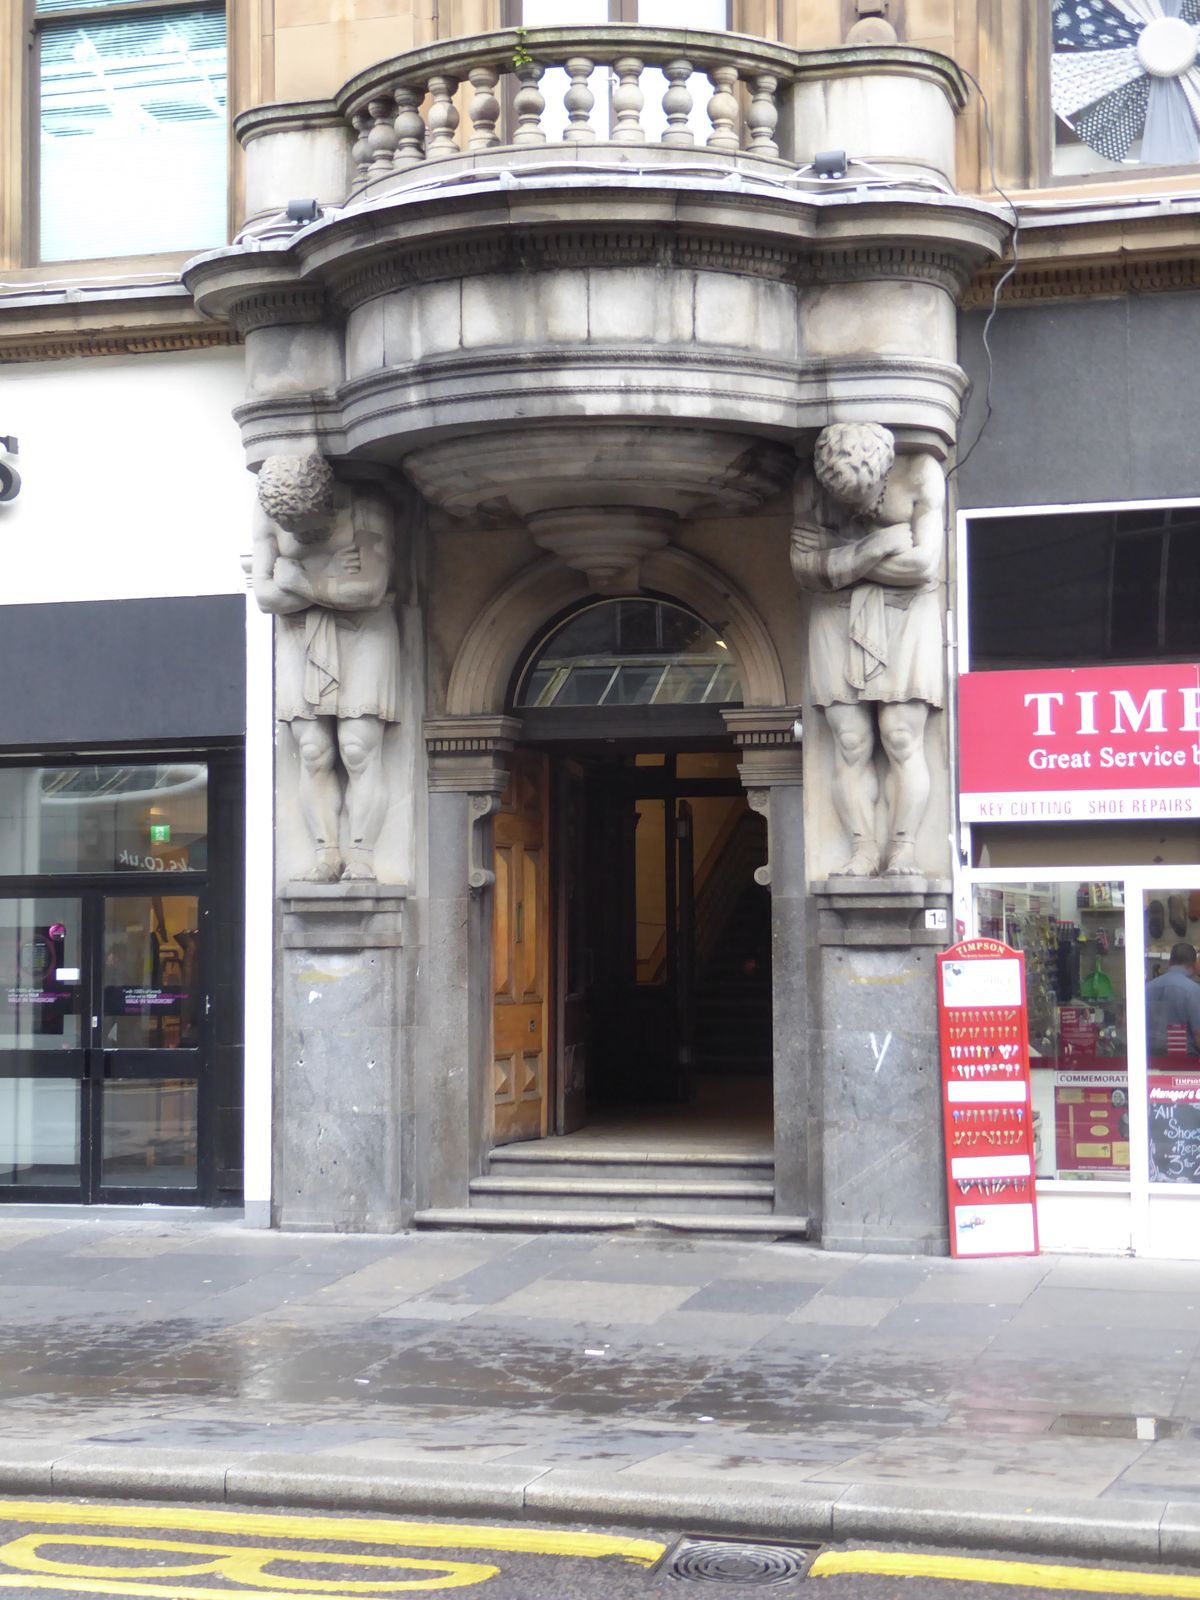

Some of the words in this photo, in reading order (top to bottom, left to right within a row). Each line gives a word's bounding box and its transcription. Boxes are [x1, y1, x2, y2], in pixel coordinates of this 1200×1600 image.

[1028, 748, 1091, 770] Great
[1099, 744, 1186, 768] Service
[980, 802, 1003, 817] KEY
[1011, 800, 1072, 816] CUTTING
[1088, 800, 1125, 814] SHOE
[1132, 798, 1193, 812] REPAIRS
[929, 911, 946, 926] 14
[955, 942, 1006, 955] TIMPSON
